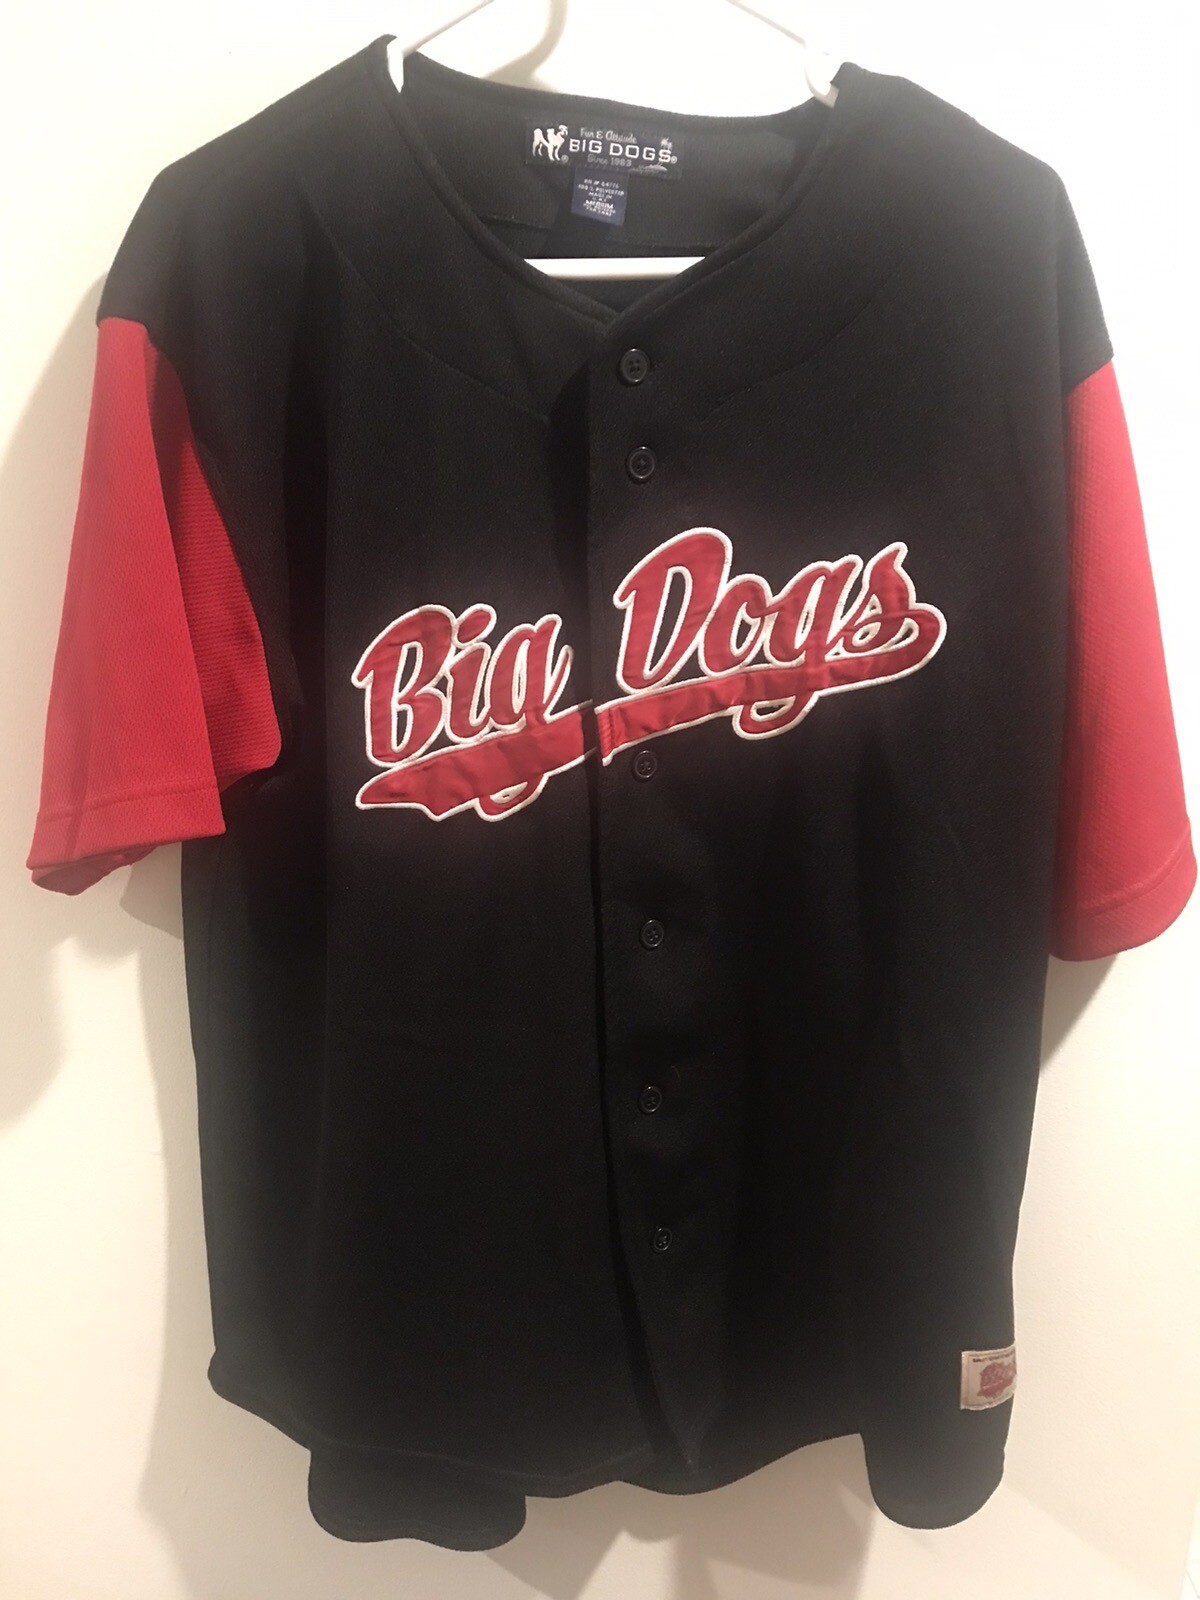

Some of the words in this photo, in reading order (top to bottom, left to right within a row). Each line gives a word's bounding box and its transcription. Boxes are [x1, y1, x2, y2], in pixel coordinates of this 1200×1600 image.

[580, 127, 594, 138] Fun
[569, 138, 602, 154] BIG
[609, 142, 672, 163] DOGS
[352, 602, 576, 821] Big
[613, 527, 947, 740] Dogs
